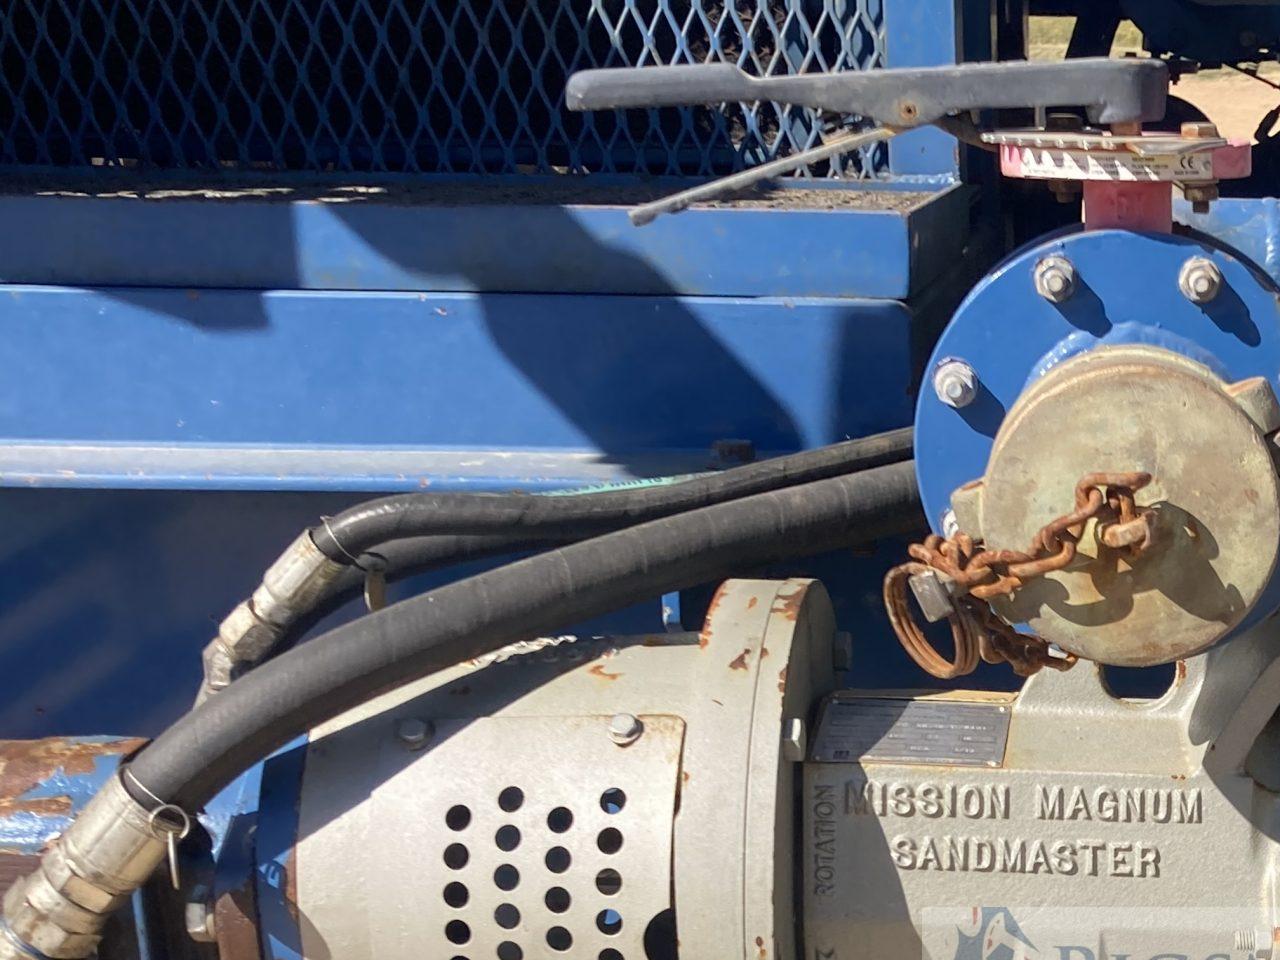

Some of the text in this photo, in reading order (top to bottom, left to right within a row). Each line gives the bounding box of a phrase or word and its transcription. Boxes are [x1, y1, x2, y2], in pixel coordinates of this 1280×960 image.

[844, 779, 1202, 824] MISSION MAGNUM
[813, 784, 836, 896] ROTATION
[890, 833, 1161, 878] SANDMASTER
